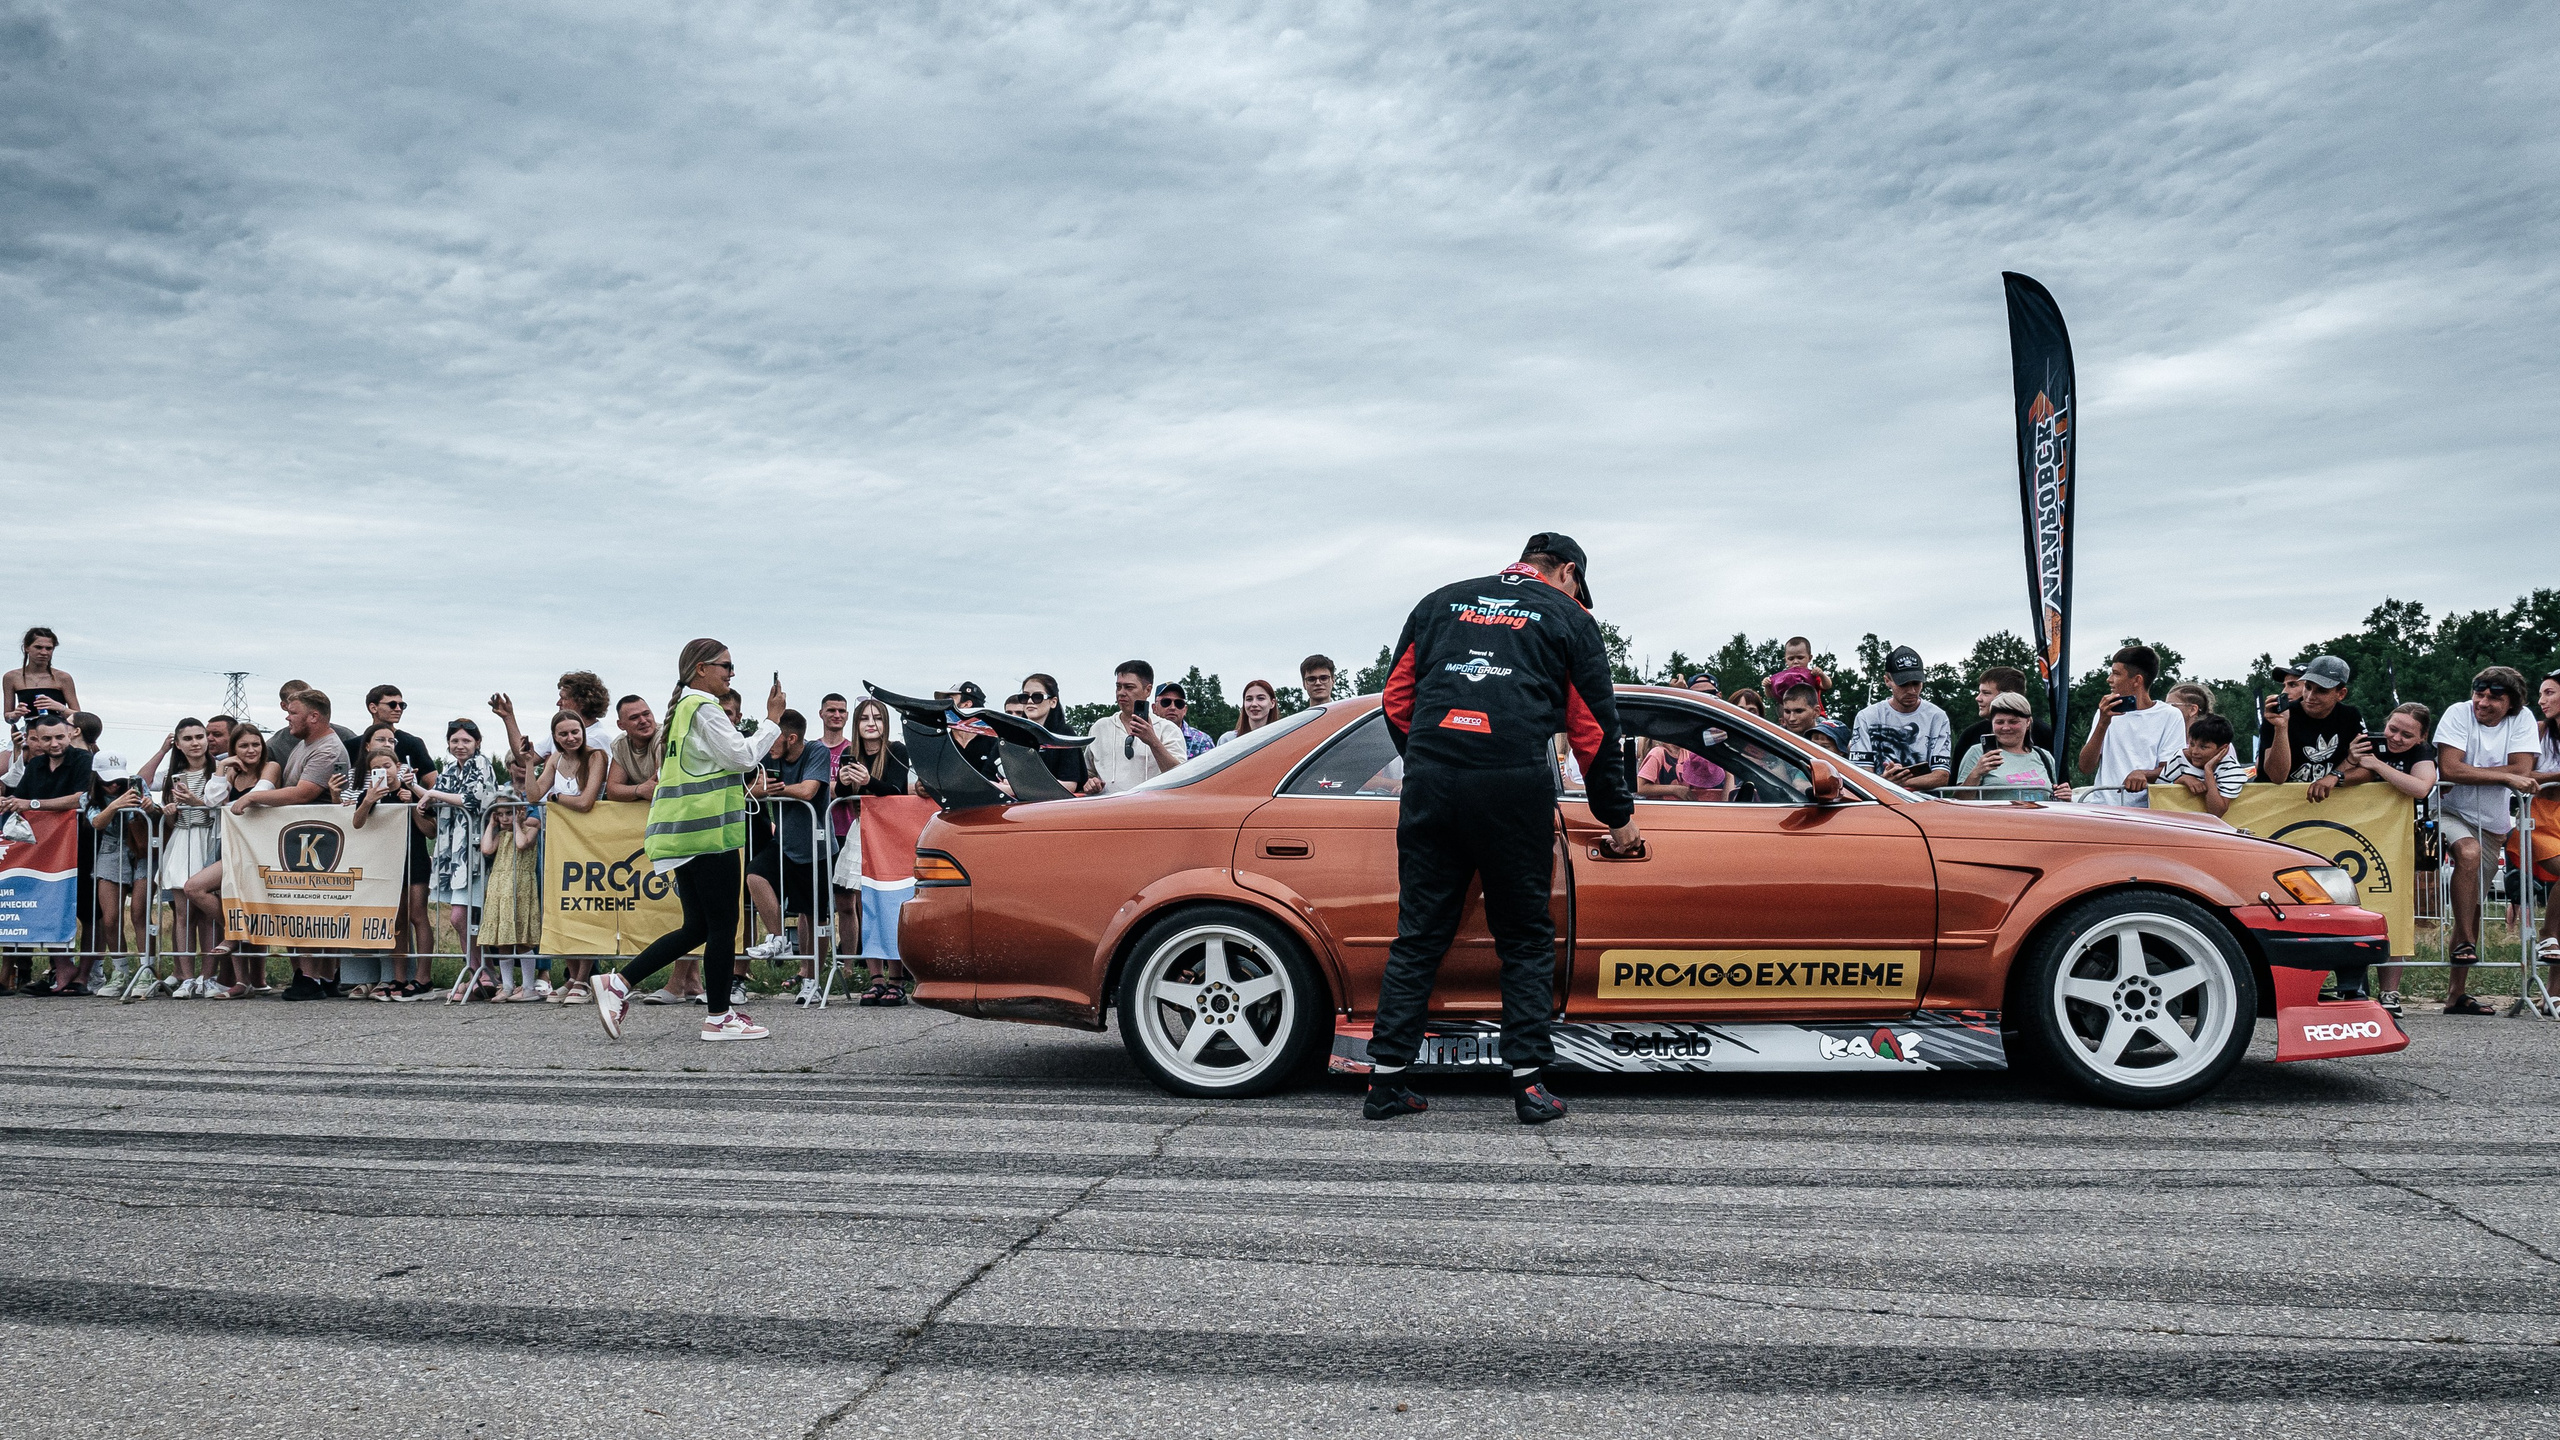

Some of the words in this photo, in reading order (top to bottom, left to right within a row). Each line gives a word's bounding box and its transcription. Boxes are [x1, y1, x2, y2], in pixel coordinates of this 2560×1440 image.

[1458, 609, 1528, 630] Racing
[1445, 663, 1512, 676] IMPORTGROUP
[266, 874, 305, 885] АТАМАН
[560, 897, 635, 911] EXTREME
[2303, 1021, 2381, 1041] RECARO
[1611, 1031, 1712, 1058] Setrab
